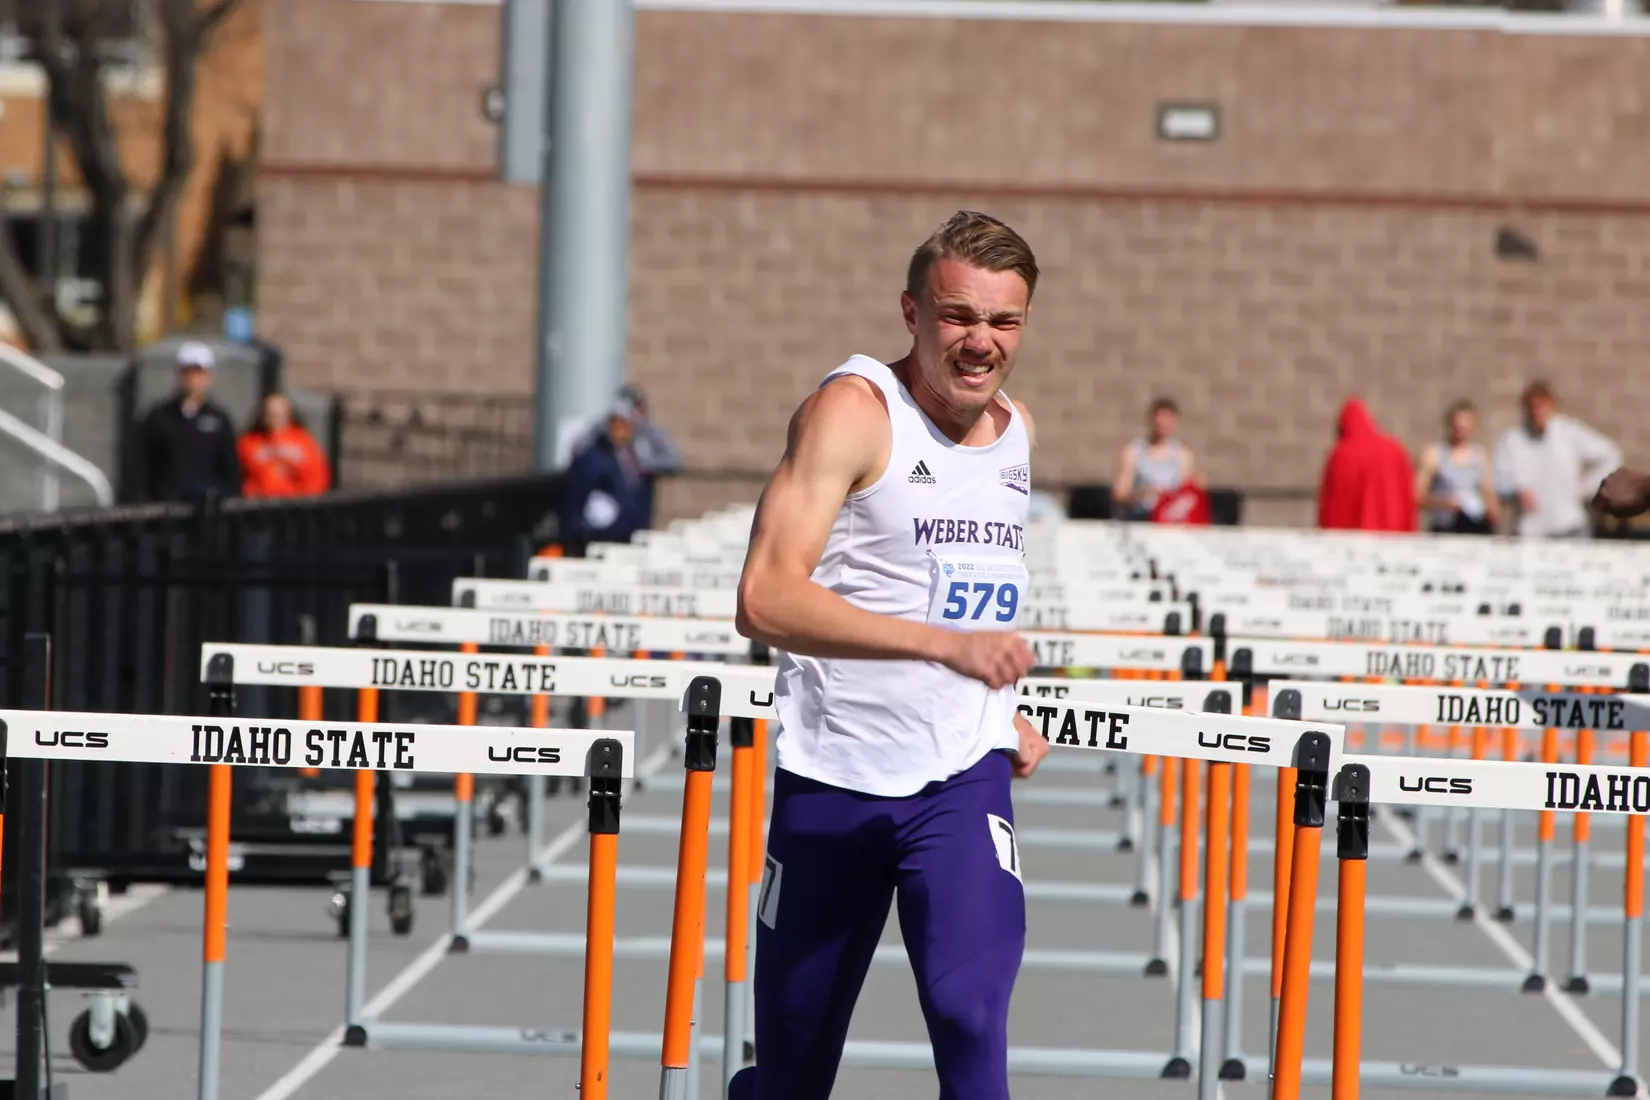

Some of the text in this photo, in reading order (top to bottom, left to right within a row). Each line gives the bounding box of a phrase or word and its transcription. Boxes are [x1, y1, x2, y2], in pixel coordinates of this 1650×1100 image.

[908, 476, 936, 484] adidas
[913, 518, 979, 546] WEBER
[942, 581, 1019, 622] 579
[488, 617, 557, 644] IDAHO
[565, 621, 642, 650] STATE
[257, 658, 666, 691] UCS IDAHO STATE UCS
[1366, 651, 1434, 676] IDAHO
[1443, 655, 1520, 681] STATE
[1323, 694, 1625, 729] UCS IDAHO STATE
[35, 724, 561, 769] UCS IDAHO STATE UCS
[1198, 731, 1271, 753] UCS
[1399, 771, 1650, 813] UCS IDAHO
